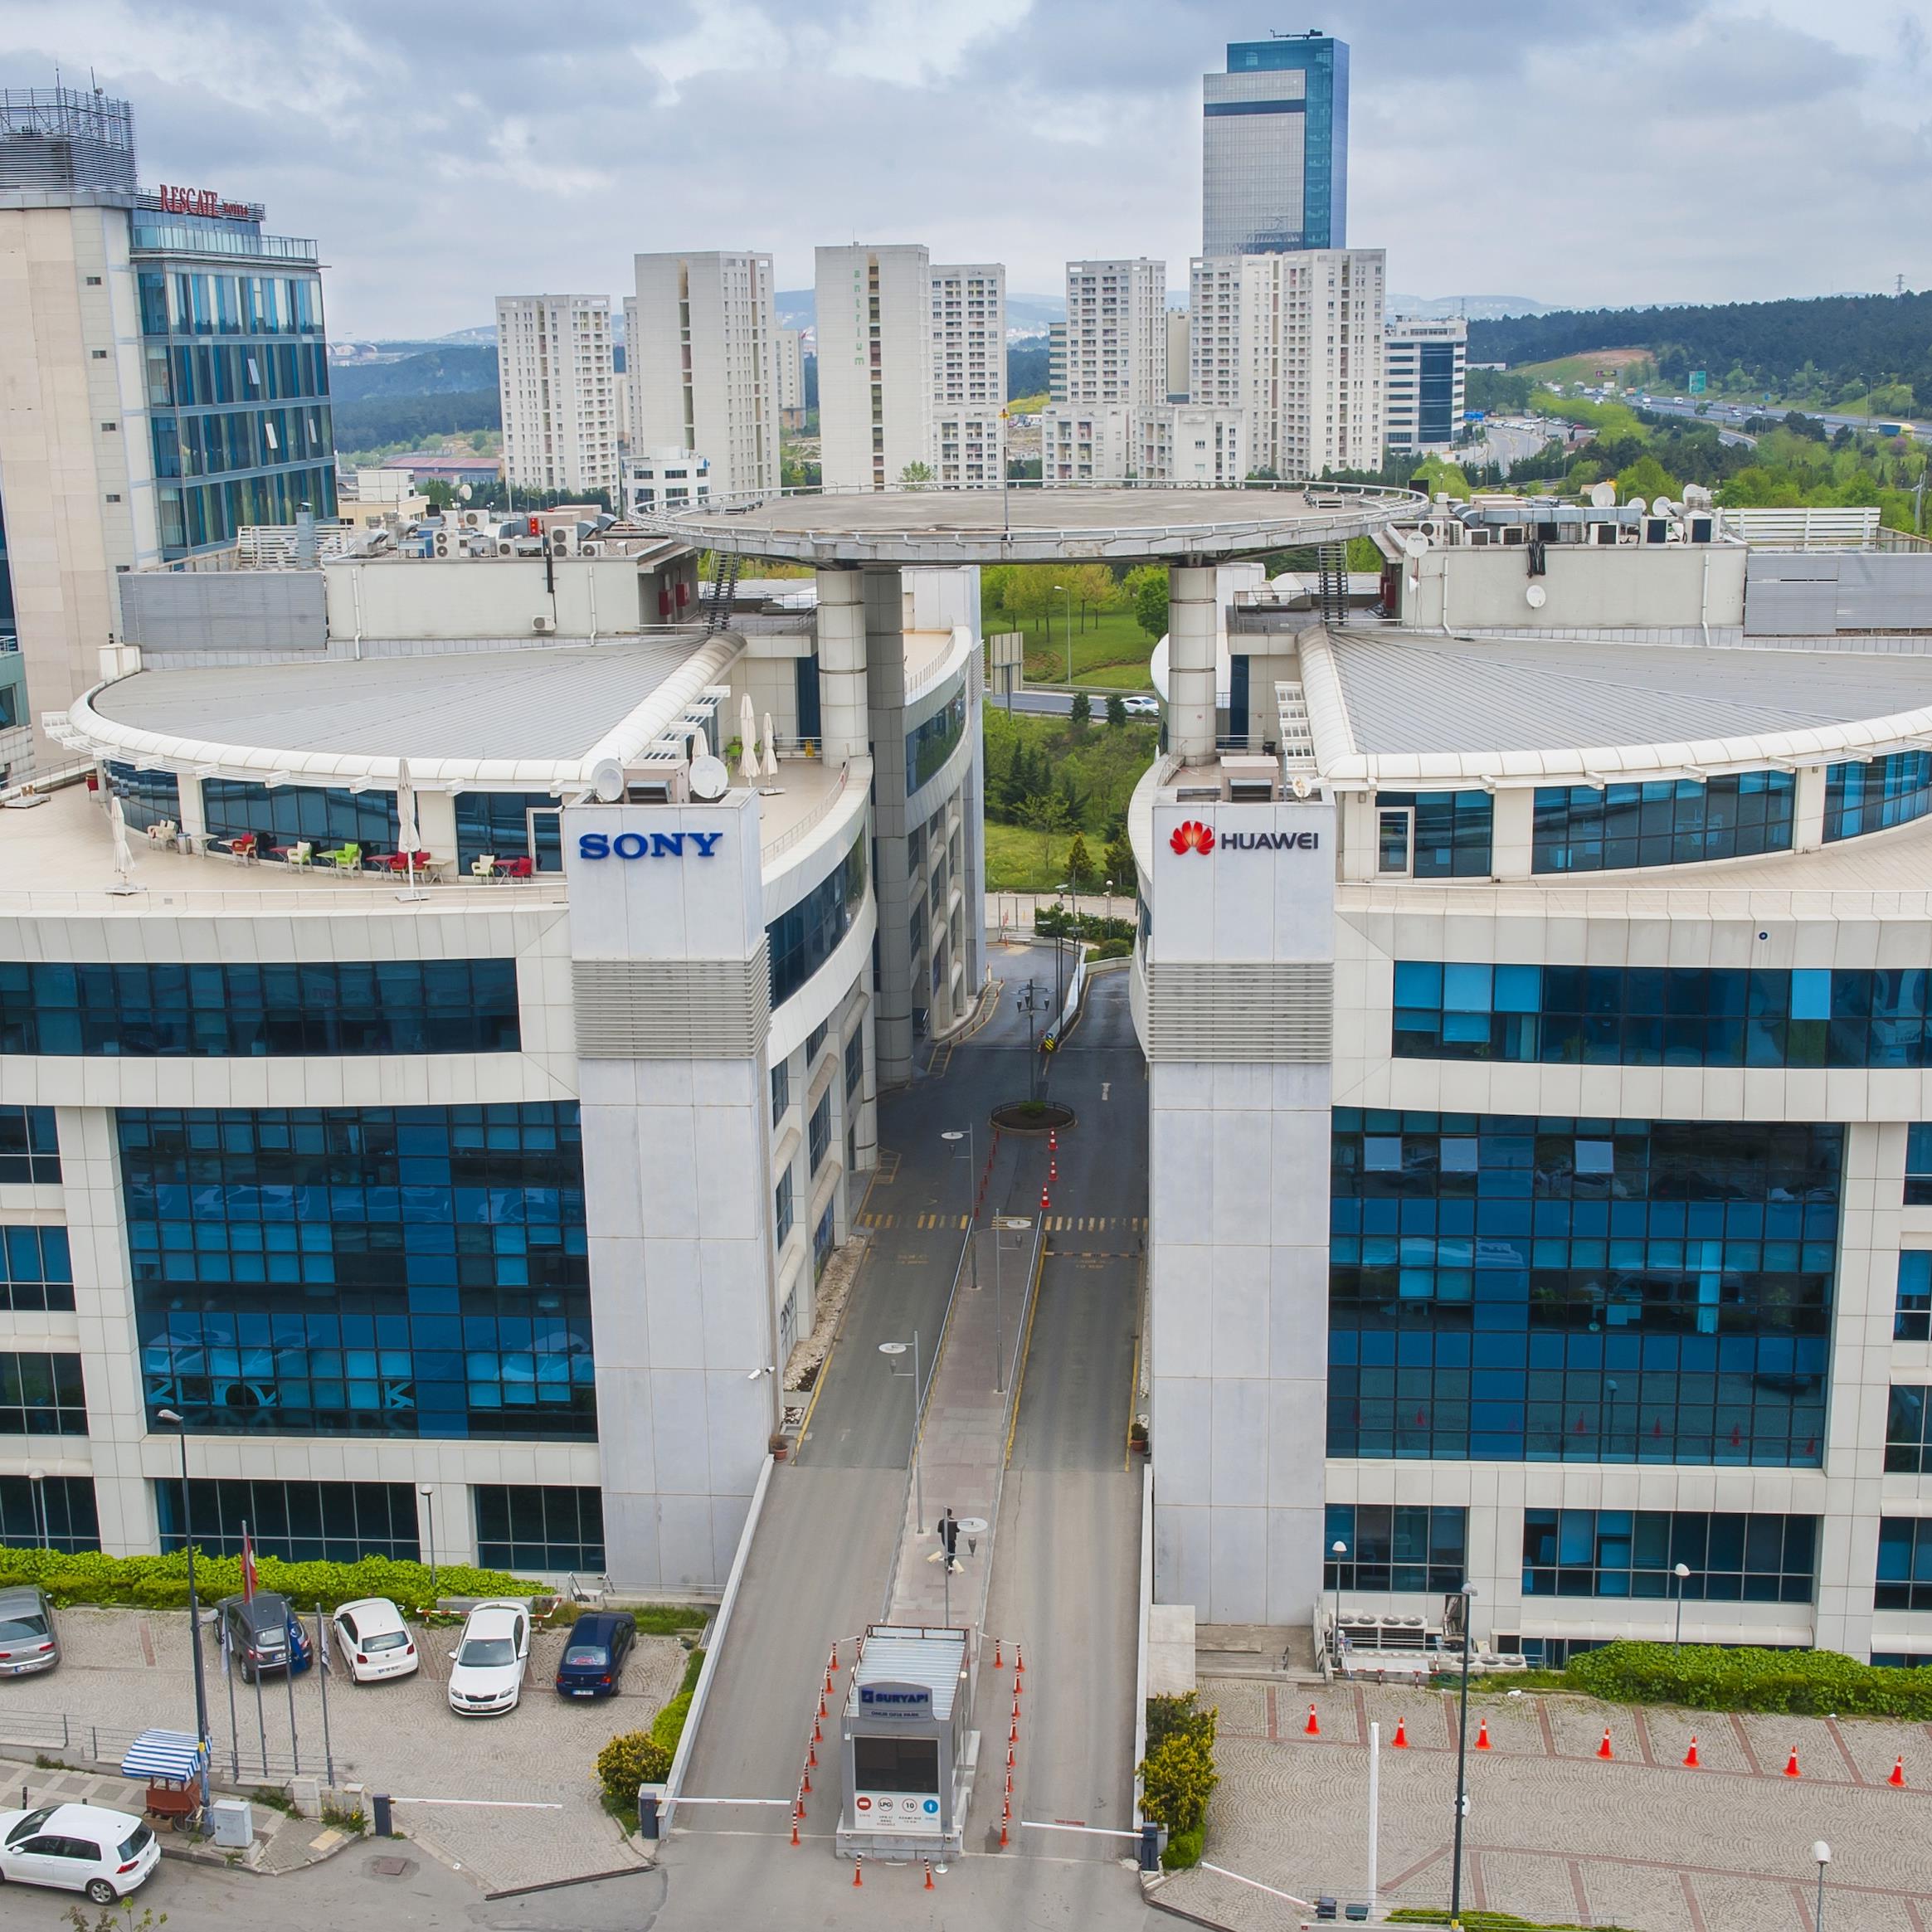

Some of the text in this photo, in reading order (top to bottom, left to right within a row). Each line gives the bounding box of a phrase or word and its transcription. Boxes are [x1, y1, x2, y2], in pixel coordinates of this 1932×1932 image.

[160, 184, 219, 217] RESCATE
[579, 833, 723, 859] SONY
[1221, 832, 1319, 850] HUAWEI
